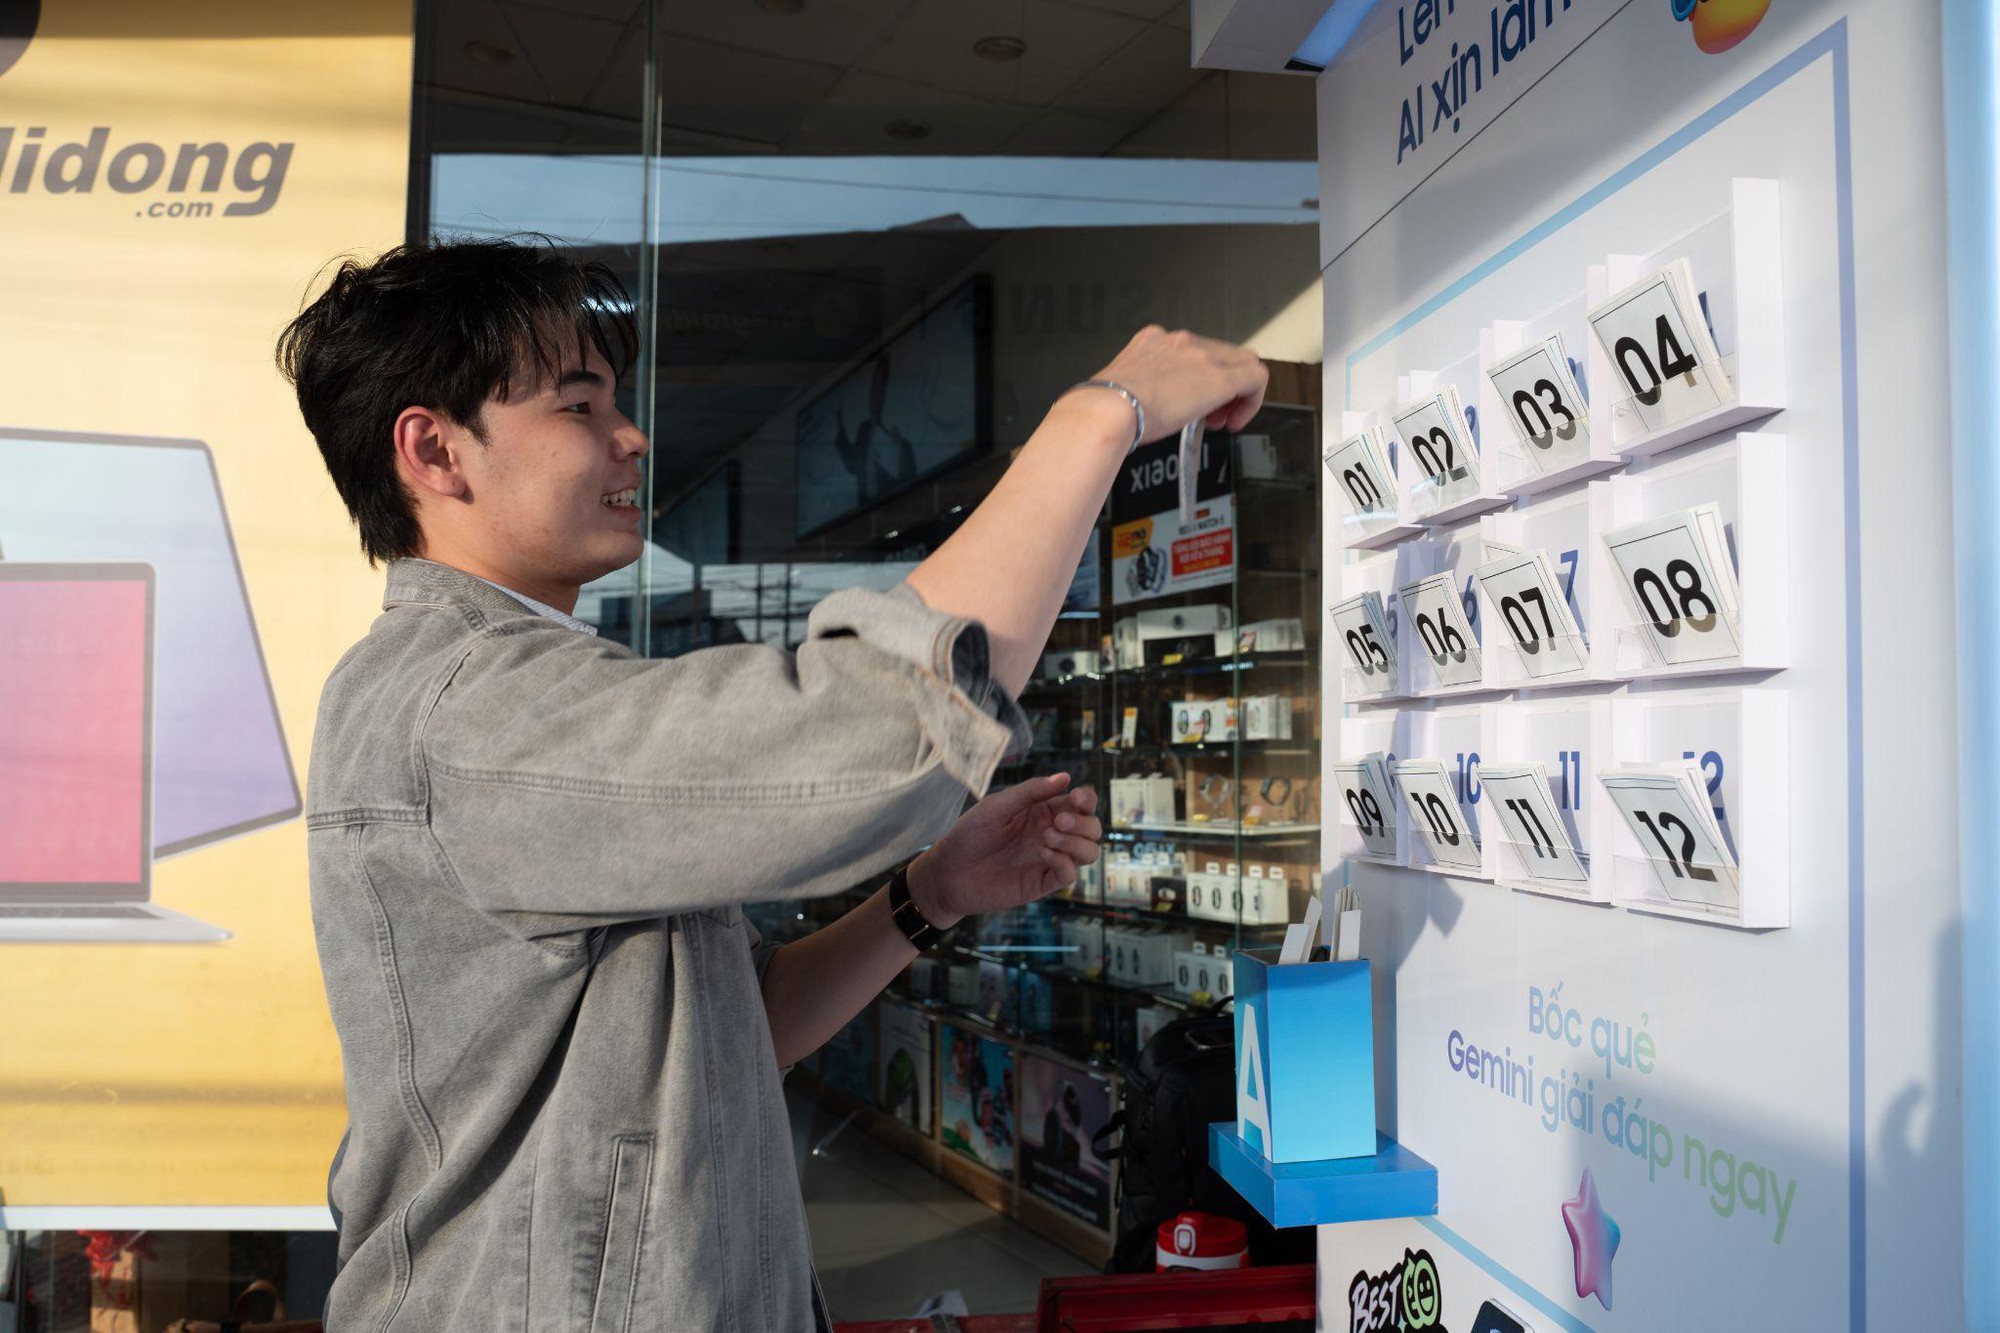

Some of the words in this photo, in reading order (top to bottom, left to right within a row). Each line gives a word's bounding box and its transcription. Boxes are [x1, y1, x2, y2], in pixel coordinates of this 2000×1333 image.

[1397, 84, 1424, 166] AI
[1431, 42, 1482, 134] xịn
[0, 126, 296, 217] idong
[135, 202, 214, 218] .com
[1614, 314, 1698, 406] 04
[1512, 378, 1577, 450] 03
[1130, 442, 1209, 494] xiaoi
[1343, 461, 1385, 514] 01
[1411, 426, 1469, 487] 02
[1500, 586, 1557, 655] 07
[1633, 558, 1717, 638] 08
[1346, 623, 1389, 676] 05
[1416, 607, 1467, 667] 06
[1346, 788, 1385, 838] 09
[1559, 751, 1581, 811] 11
[1410, 792, 1460, 847] 10
[1504, 798, 1559, 859] 11
[1632, 810, 1719, 883] 12
[1528, 981, 1583, 1048] Bốc
[1590, 1011, 1657, 1080] quẻ
[1237, 1002, 1274, 1164] A
[1447, 1029, 1534, 1107] Gemini
[1540, 1067, 1594, 1135] giải
[1601, 1095, 1674, 1184] đáp
[1683, 1133, 1797, 1246] ngay
